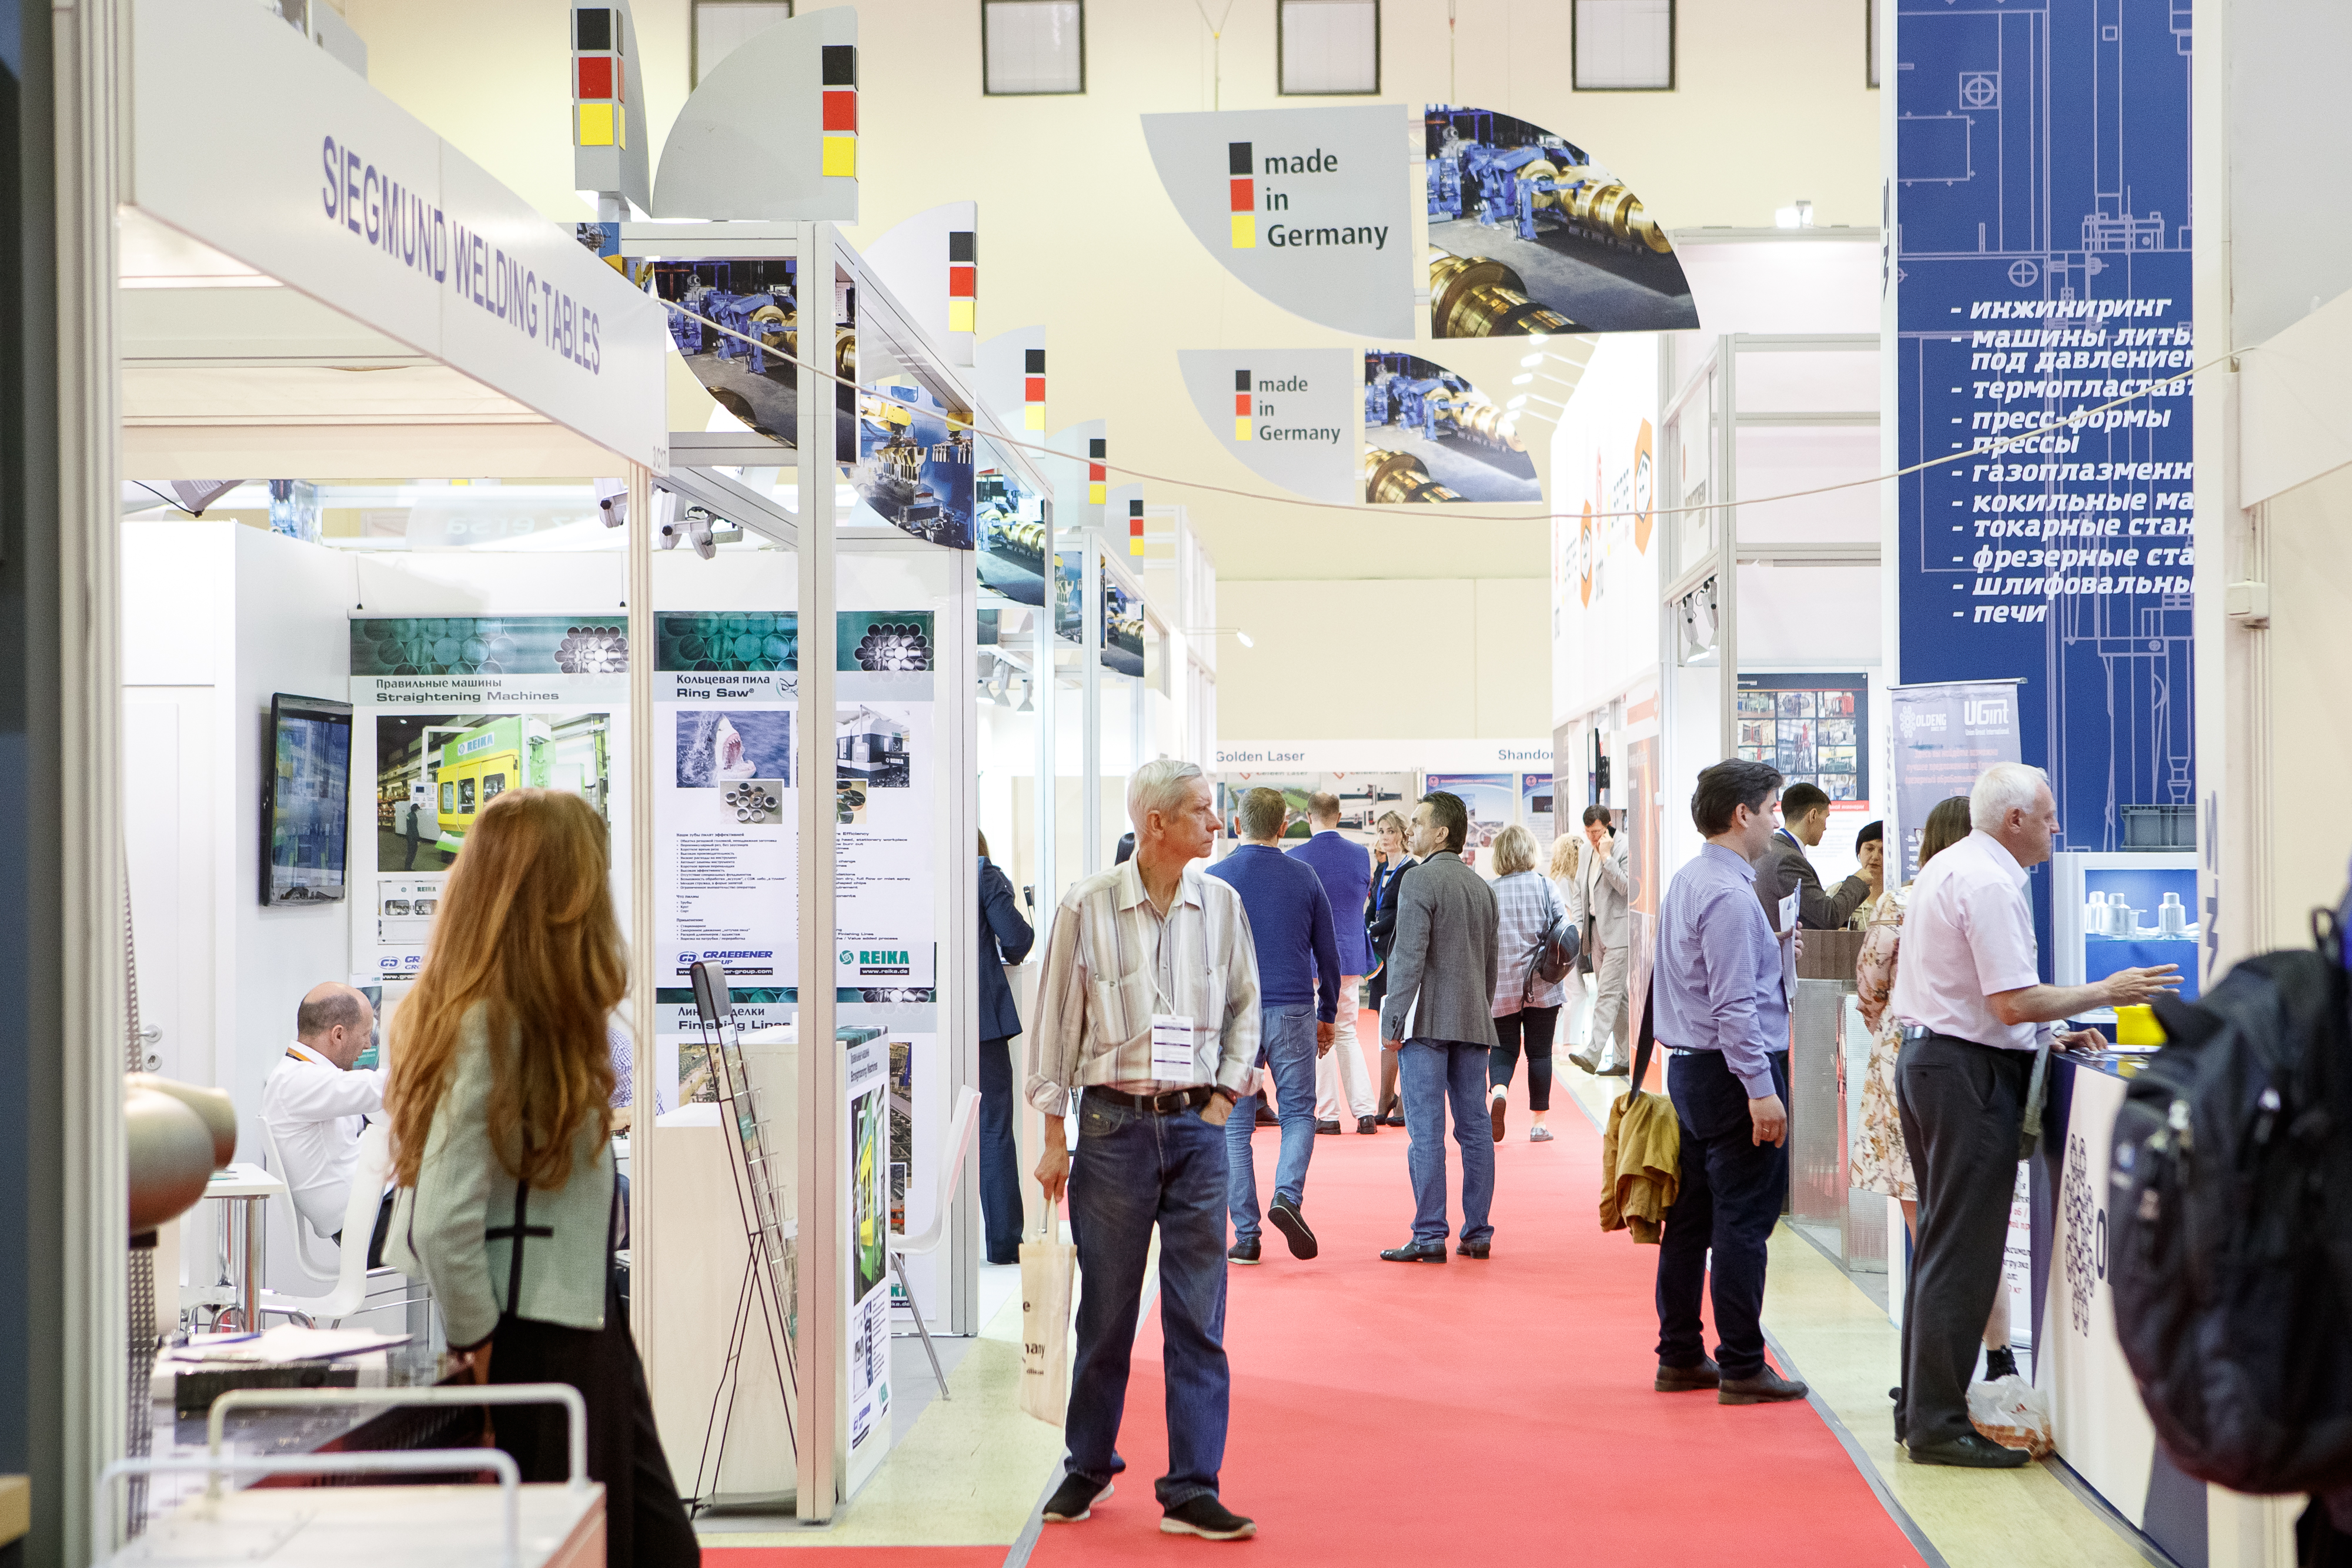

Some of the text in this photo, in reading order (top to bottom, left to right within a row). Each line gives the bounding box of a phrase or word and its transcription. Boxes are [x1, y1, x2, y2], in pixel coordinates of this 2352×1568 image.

[1265, 148, 1338, 175] made
[1266, 187, 1289, 211] in
[1267, 225, 1389, 250] Germany
[323, 136, 600, 376] SIEGMUND WELDING TABLES
[1970, 298, 2171, 322] инжиниринг
[1972, 327, 2193, 348] машины лить
[1972, 352, 2027, 373] под
[1259, 376, 1308, 392] made
[1259, 400, 1275, 416] in
[1972, 405, 2170, 434] пресс-формы
[1259, 425, 1341, 444] Germany
[1972, 434, 2079, 459] прессы
[1972, 461, 2193, 482] газоплазменн
[1973, 492, 2146, 513] кокильные
[1974, 518, 2120, 541] токарные
[1973, 545, 2139, 573] фрезерные
[1974, 605, 2047, 623] печи
[376, 679, 502, 690] Правильные машины
[677, 674, 770, 686] Кольцевая пила
[376, 691, 559, 703] Straightening Machines
[677, 688, 710, 699] Ring
[1916, 713, 1947, 727] OLDENG
[1964, 699, 2009, 726] UGint
[1217, 751, 1305, 763] Golden Laser
[860, 950, 910, 964] REIKA
